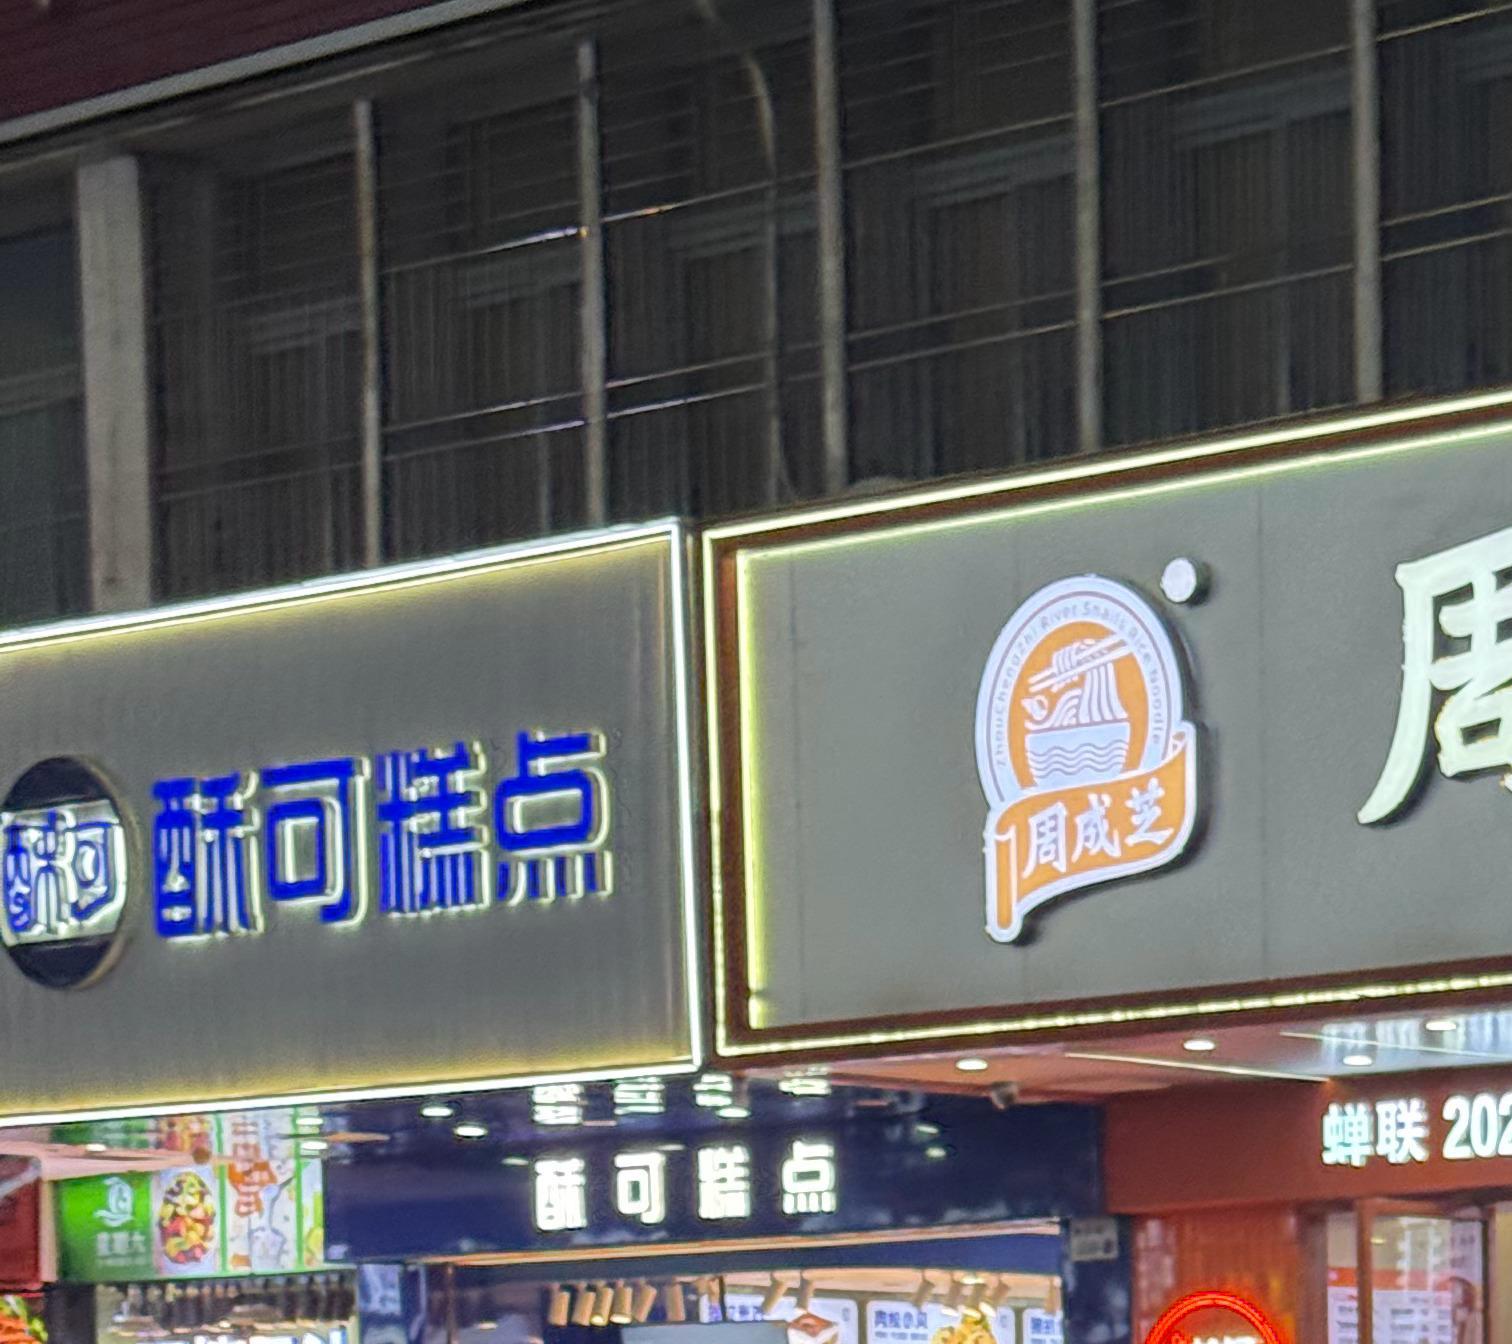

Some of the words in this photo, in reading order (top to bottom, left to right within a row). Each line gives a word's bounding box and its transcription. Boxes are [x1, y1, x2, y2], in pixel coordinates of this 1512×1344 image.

[153, 730, 612, 938] 酥可糕点
[1023, 777, 1174, 878] 周成芝
[1321, 1098, 1430, 1167] 蝉联
[534, 1140, 837, 1231] 酥可糕点
